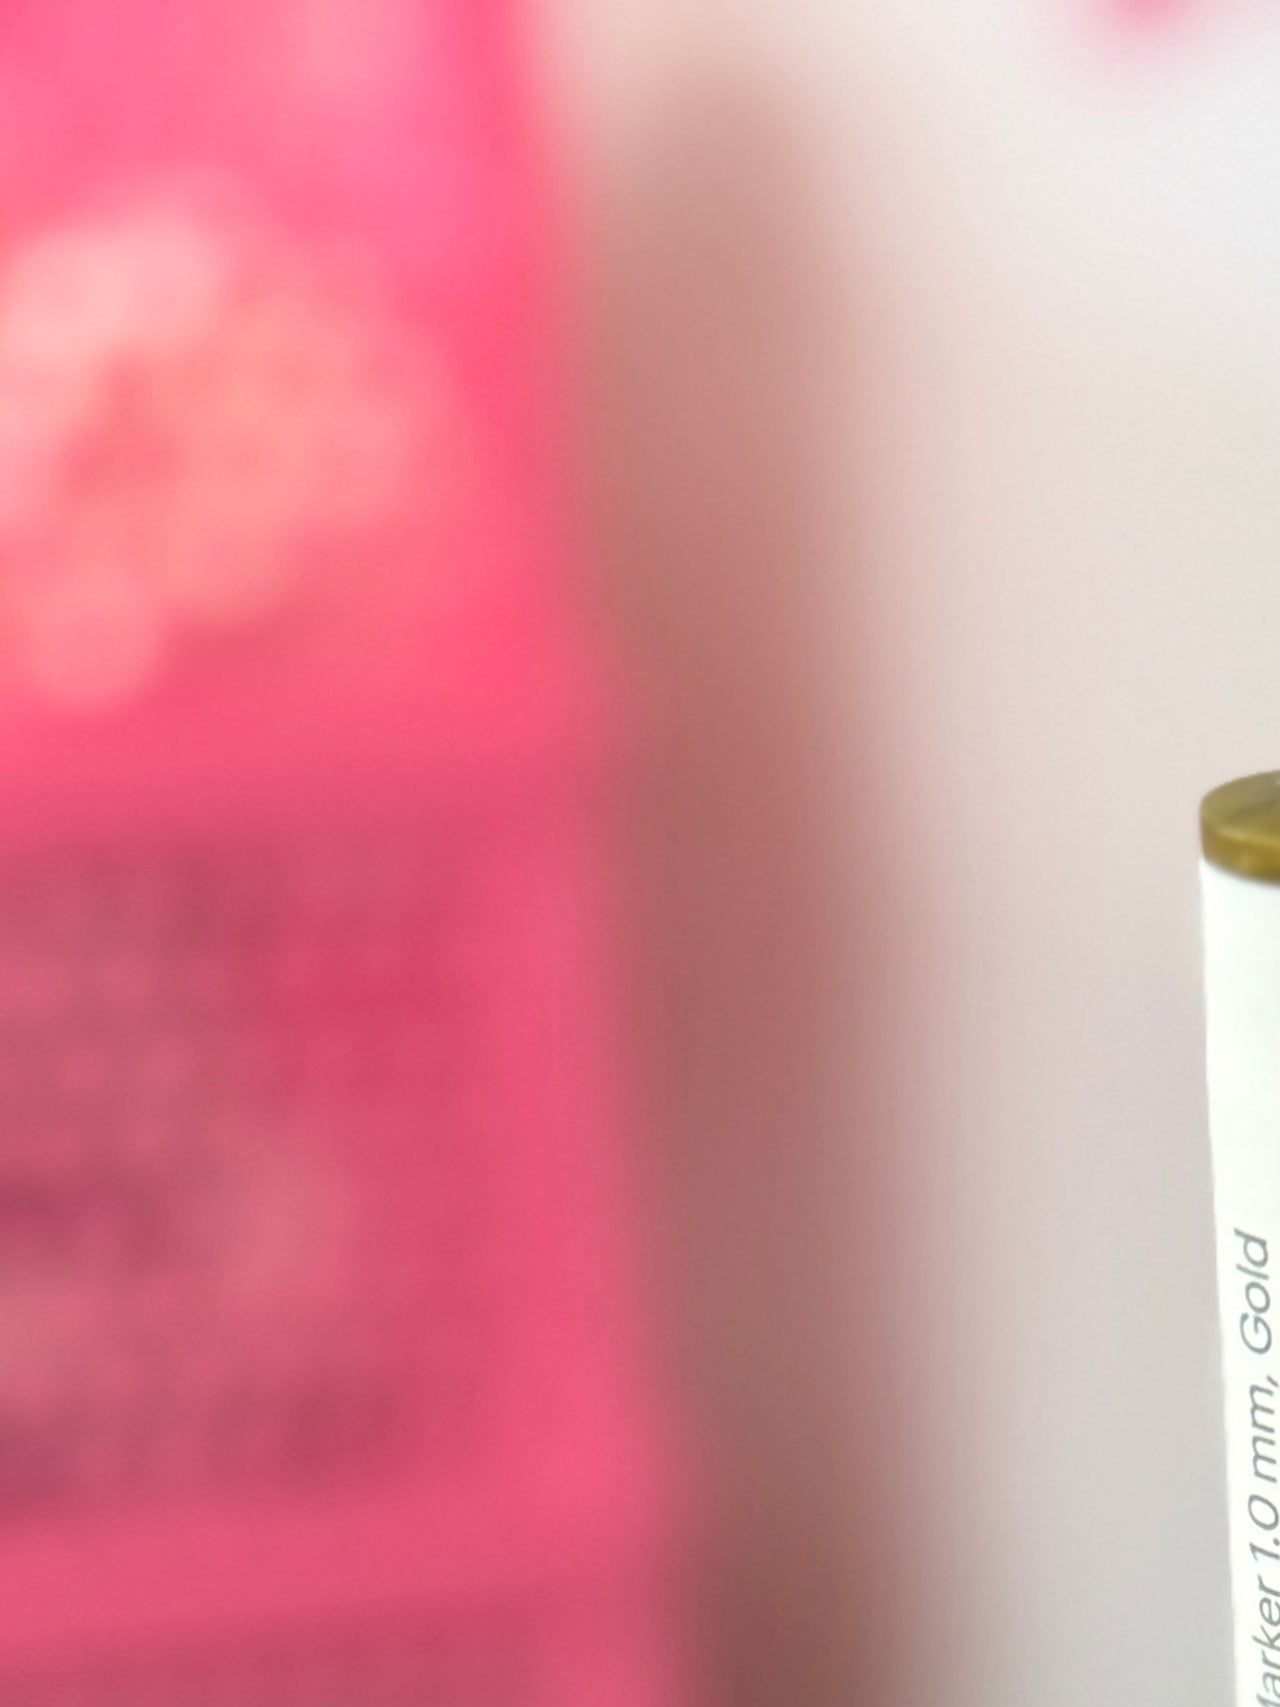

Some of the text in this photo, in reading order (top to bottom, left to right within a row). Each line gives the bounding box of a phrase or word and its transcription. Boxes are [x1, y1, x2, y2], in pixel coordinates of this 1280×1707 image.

[1233, 1226, 1273, 1355] Gold
[1248, 1374, 1280, 1484] mm,
[1247, 1494, 1280, 1562] 1.0
